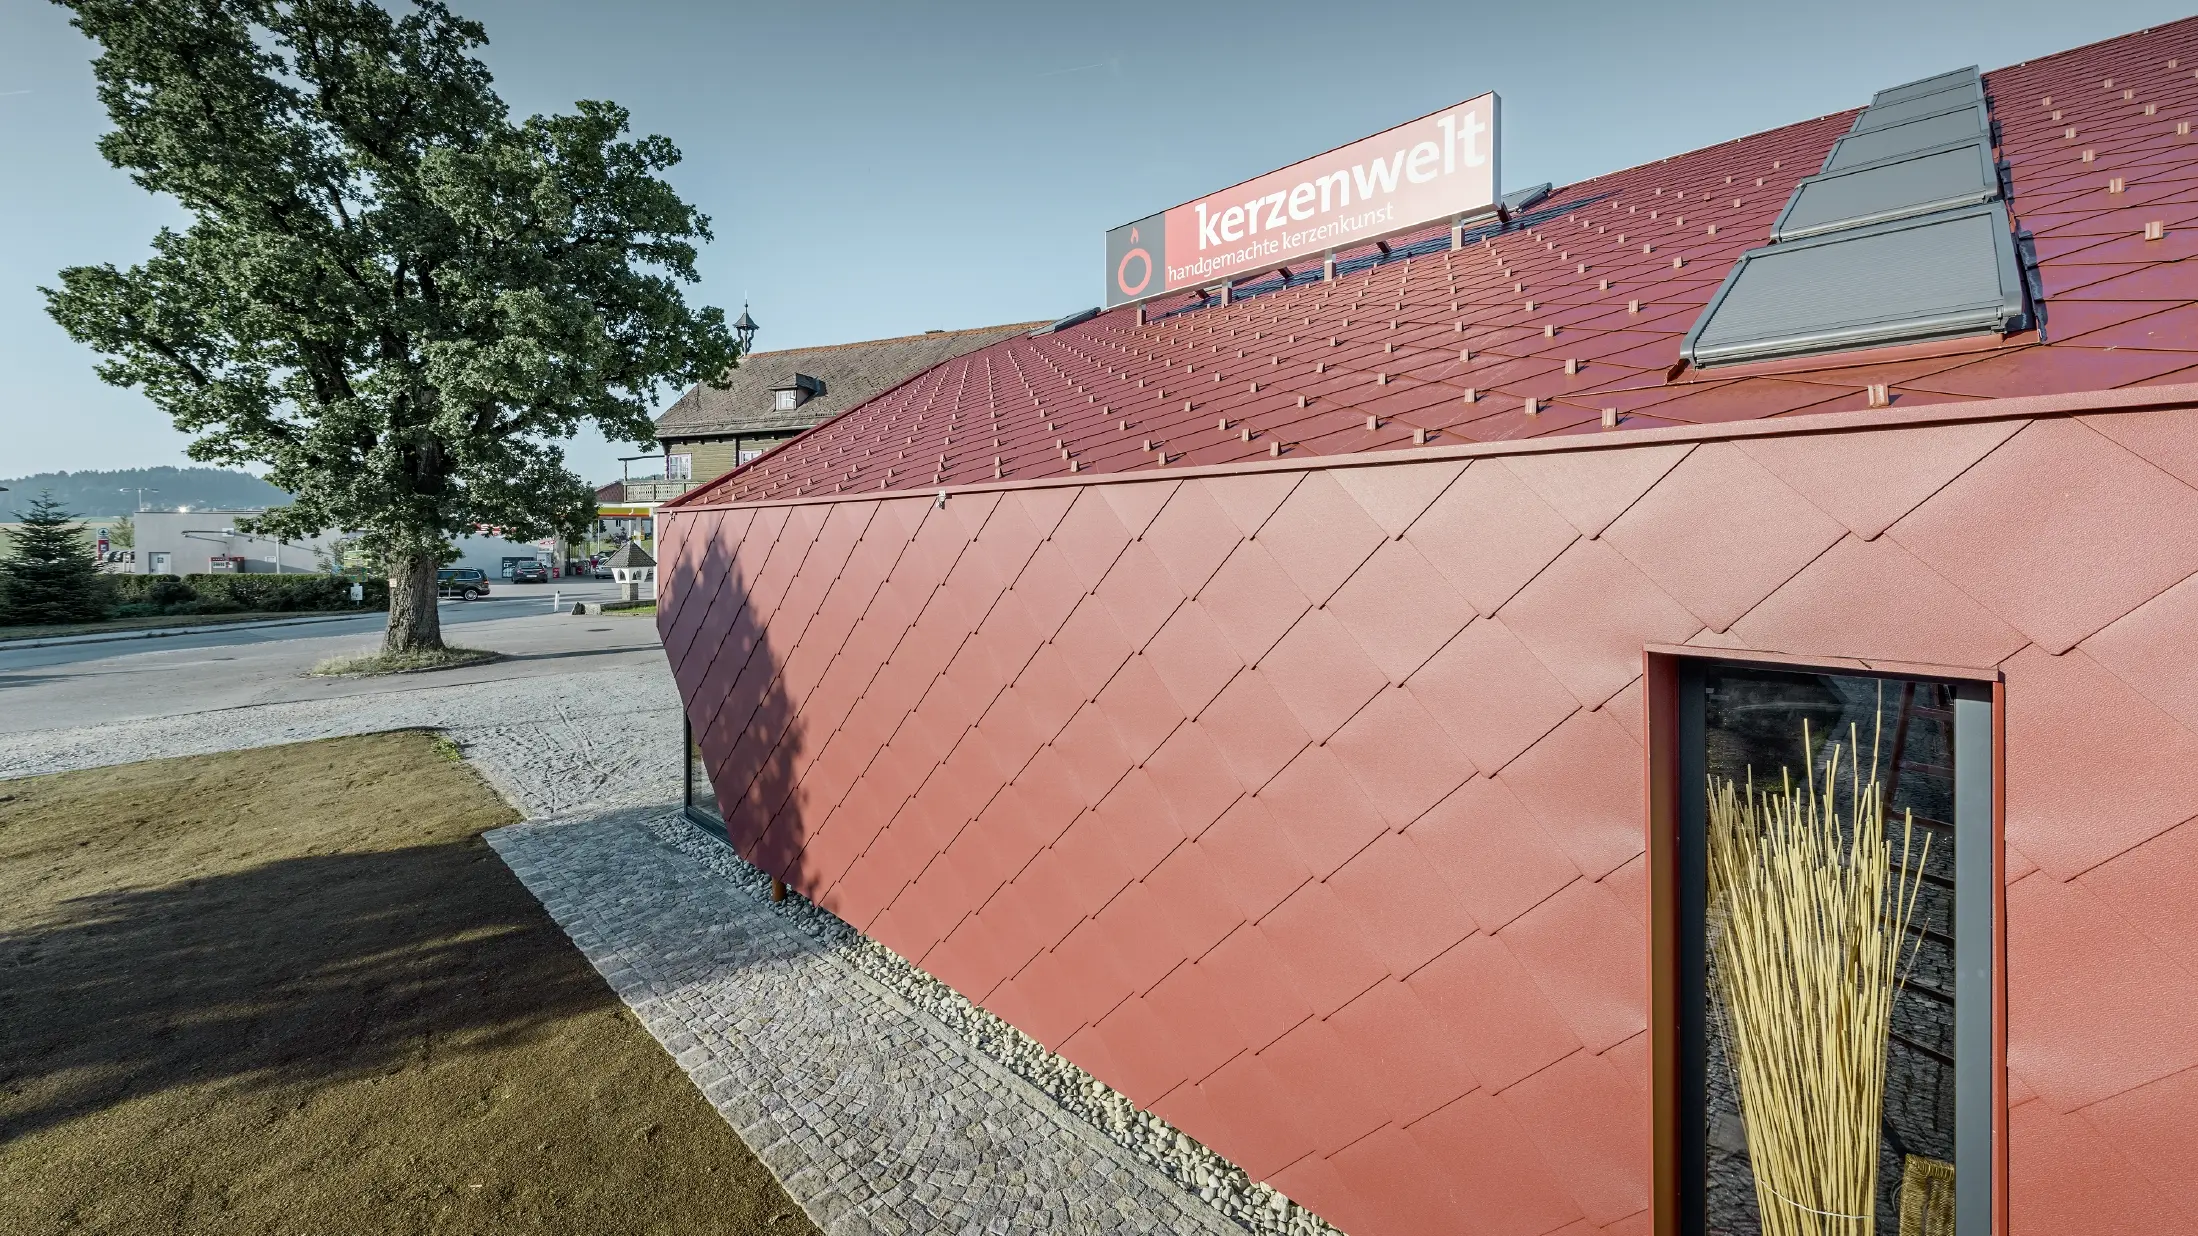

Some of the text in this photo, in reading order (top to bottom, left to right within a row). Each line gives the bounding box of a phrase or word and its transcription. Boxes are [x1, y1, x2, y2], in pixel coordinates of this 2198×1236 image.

[1195, 111, 1486, 251] kerzenwelt
[1168, 202, 1395, 282] handgemachte kerzenkunst
